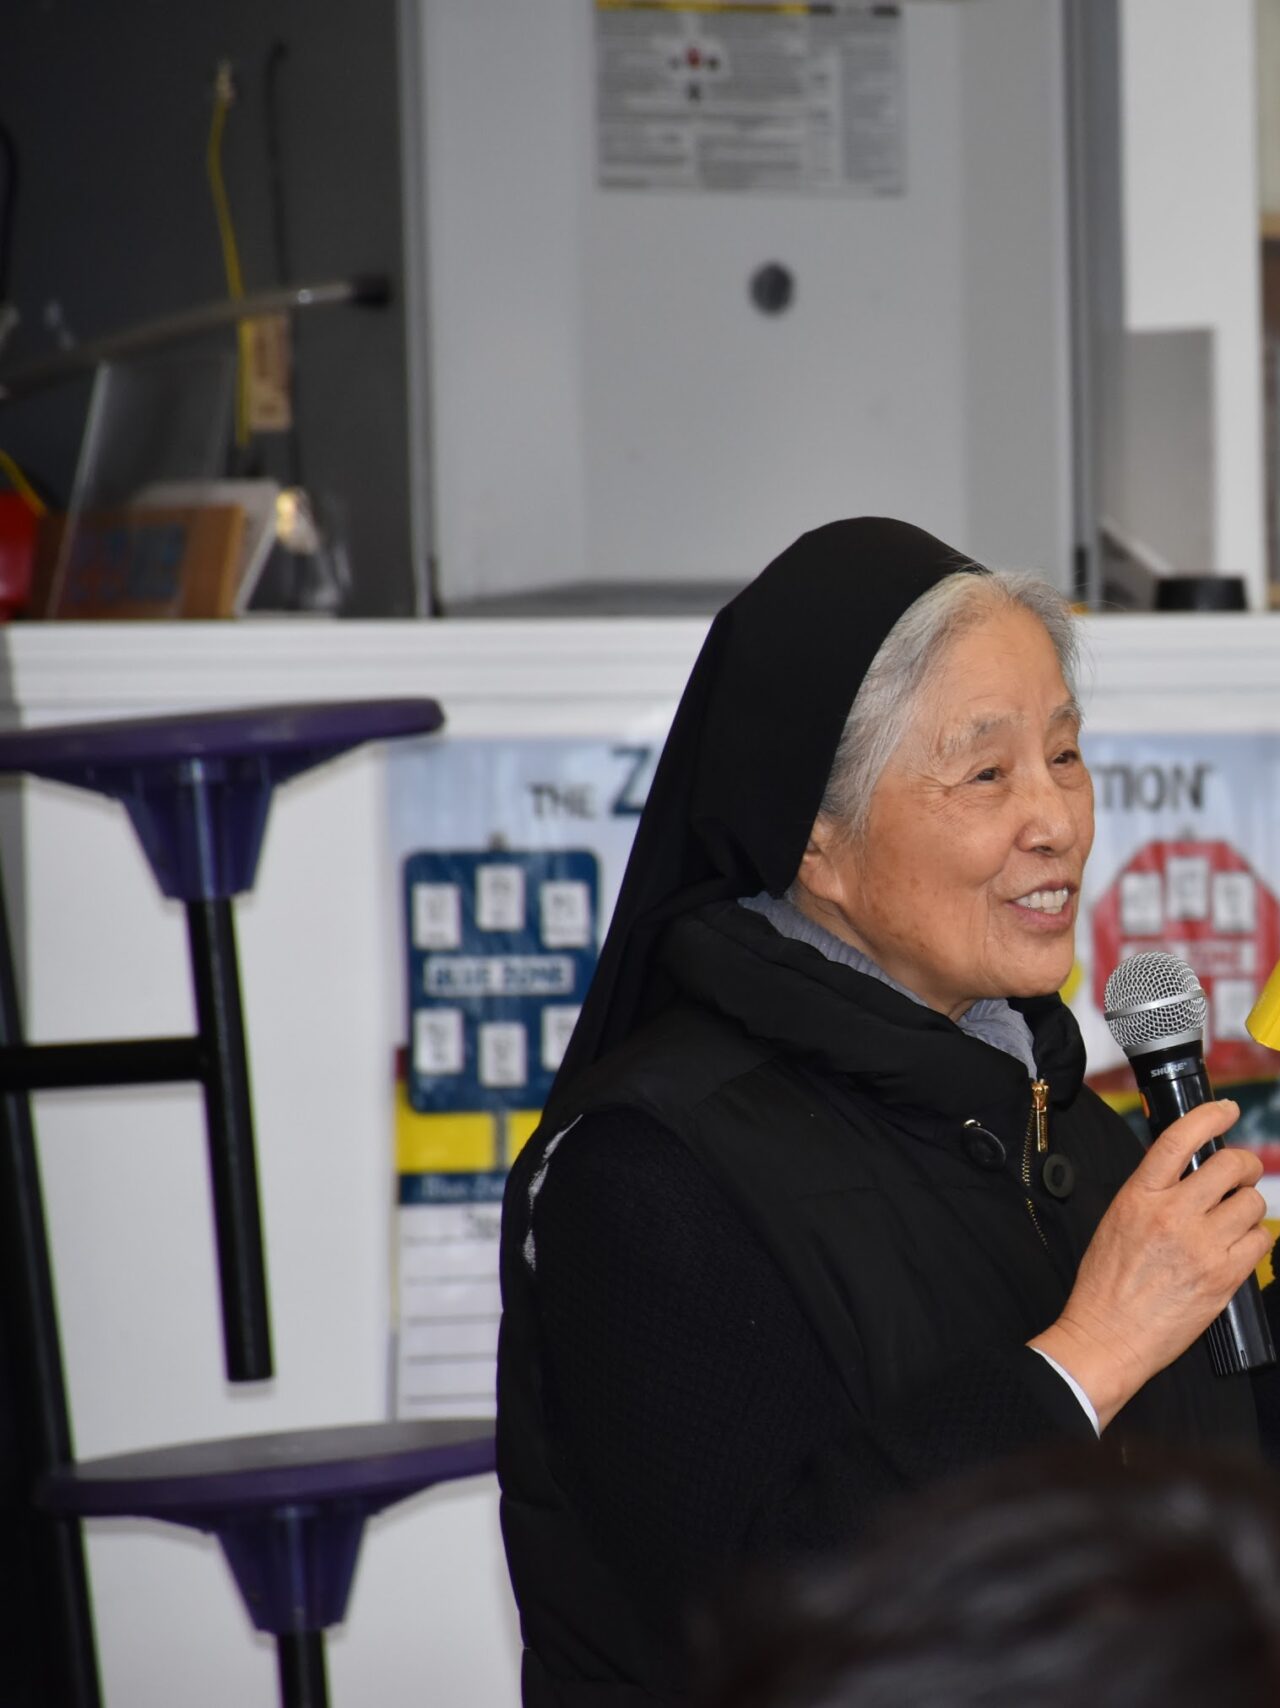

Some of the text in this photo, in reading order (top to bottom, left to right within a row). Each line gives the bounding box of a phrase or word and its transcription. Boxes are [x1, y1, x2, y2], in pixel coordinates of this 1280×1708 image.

[531, 744, 1210, 819] THE Z TION
[1150, 1062, 1185, 1078] SHURE
